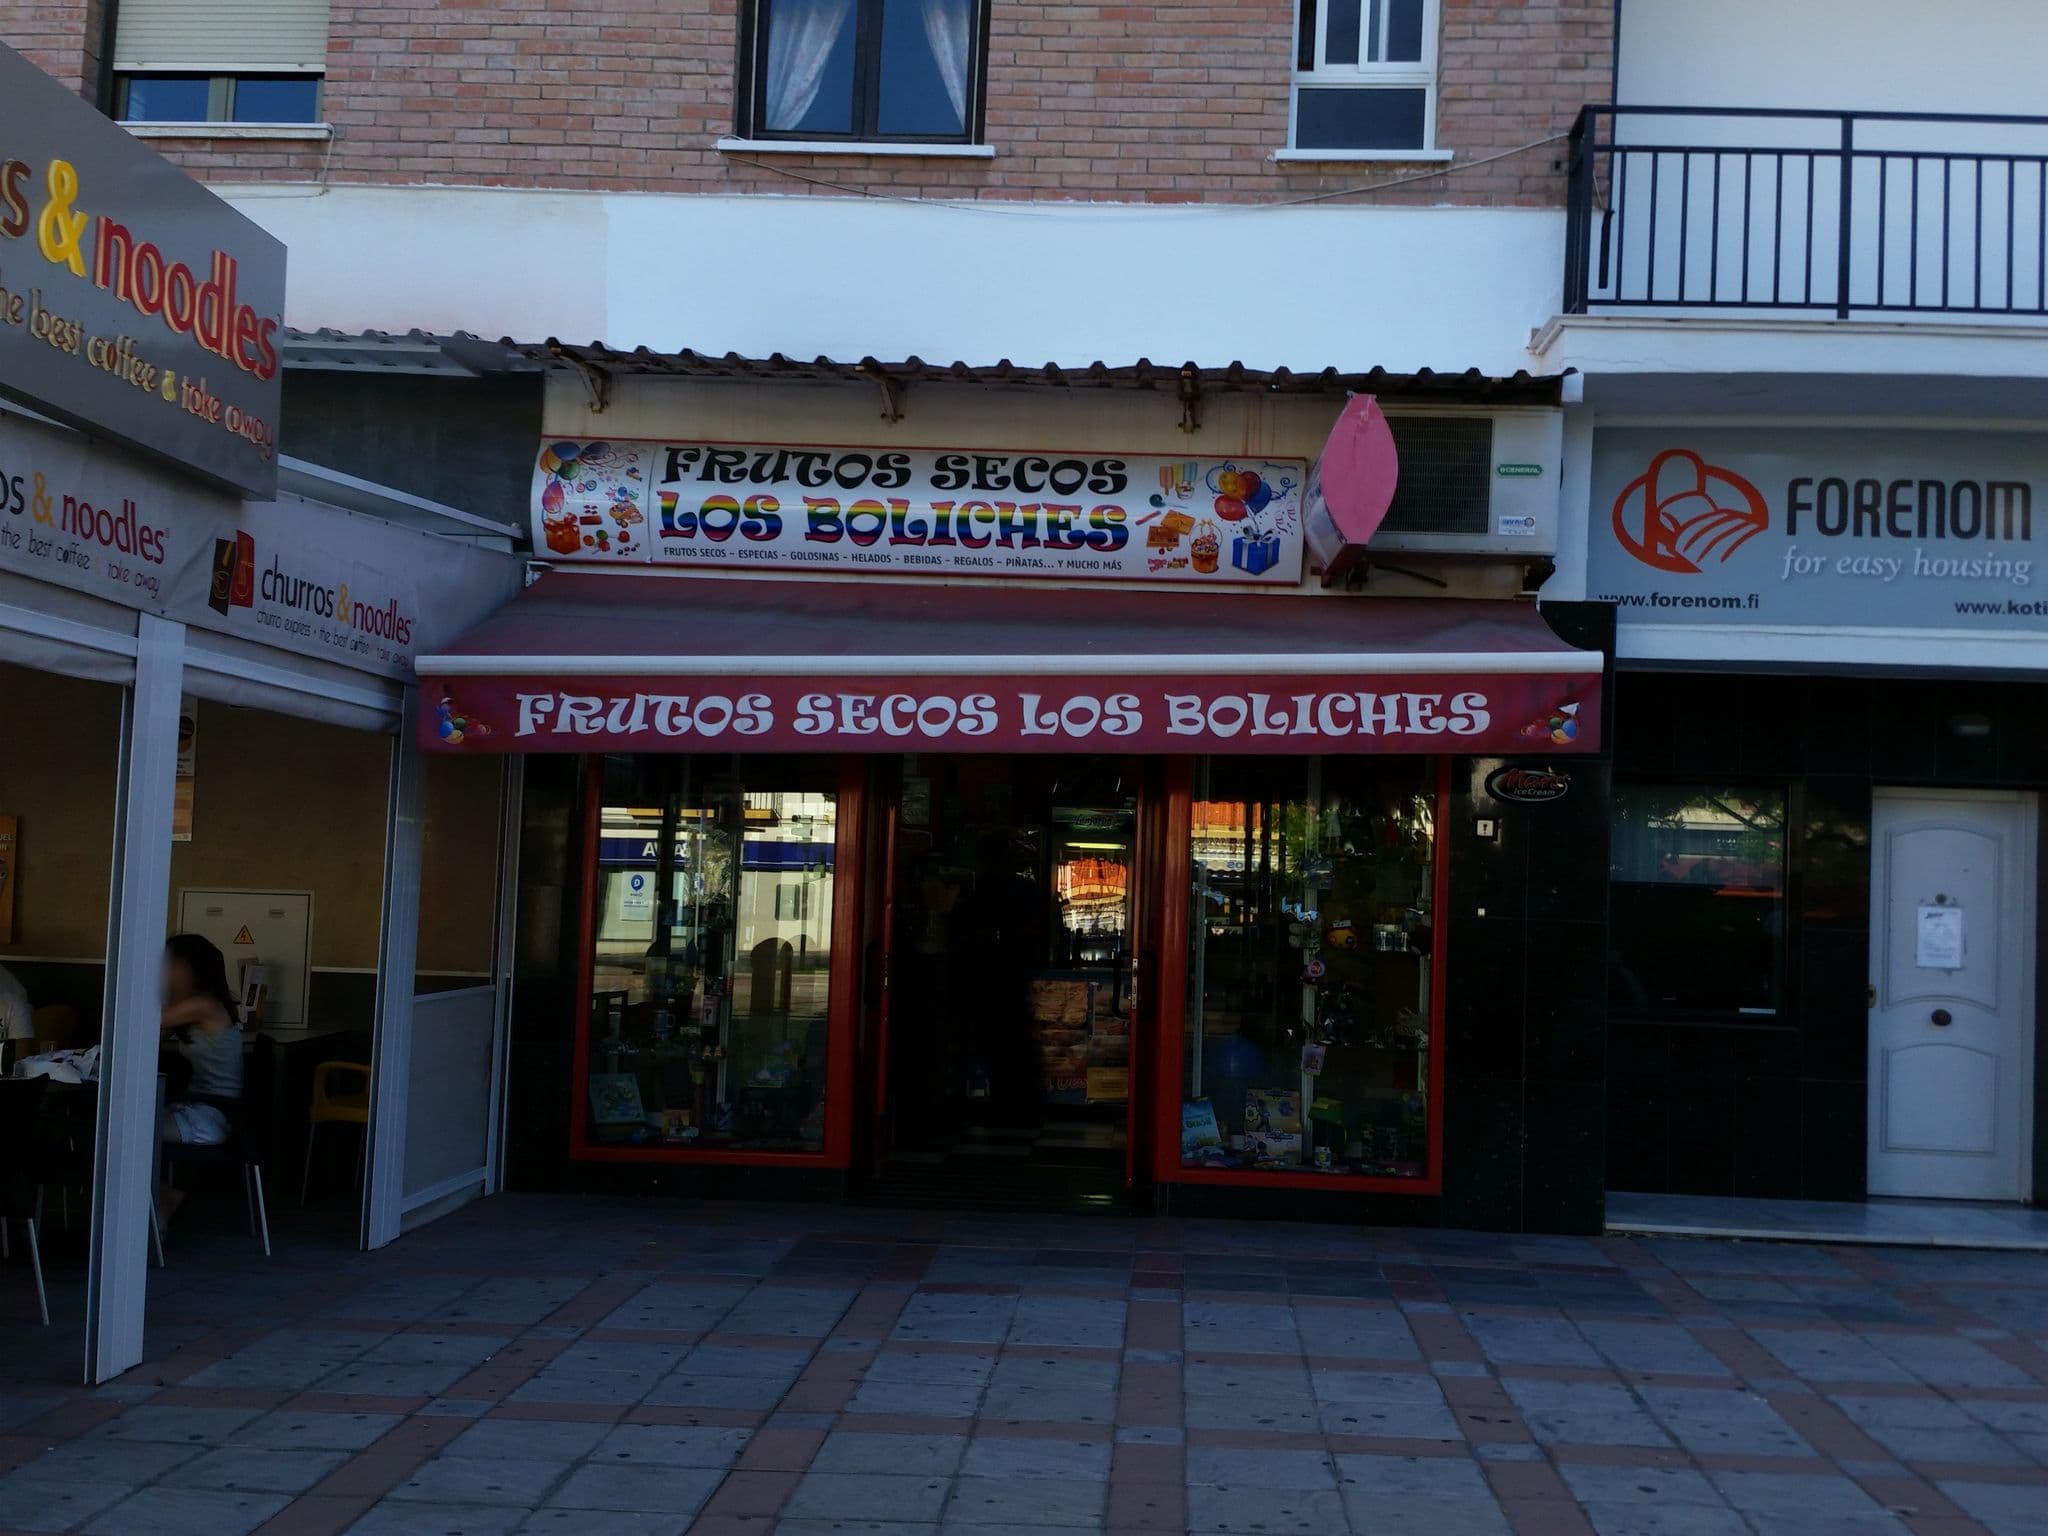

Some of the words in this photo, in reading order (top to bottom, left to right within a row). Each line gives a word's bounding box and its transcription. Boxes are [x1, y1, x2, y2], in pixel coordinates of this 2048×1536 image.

[37, 159, 88, 278] &
[93, 216, 278, 382] noodles
[29, 287, 85, 358] best
[87, 335, 158, 393] coffee
[181, 375, 222, 424] take
[225, 404, 273, 462] away
[661, 446, 911, 489] FRUTOS
[930, 455, 1128, 495] SECOS
[32, 471, 55, 528] &
[61, 494, 165, 565] noodles
[657, 491, 783, 541] LOS
[803, 495, 1129, 552] BOLICHES
[1786, 477, 2032, 541] FORENOM
[1, 520, 21, 550] the
[28, 528, 51, 558] best
[55, 542, 90, 571] coffee
[107, 559, 130, 583] take
[135, 572, 161, 600] away
[663, 547, 697, 558] FRUTOS
[700, 548, 726, 559] SECOS
[738, 549, 778, 560] ESPECIAS
[790, 551, 839, 562] GOLOSINAS
[851, 552, 891, 564] HELADOS
[904, 555, 942, 565] BEBIDAS
[954, 556, 994, 567] REGALOS
[1058, 559, 1064, 569] Y
[1067, 560, 1099, 570] MUCHO
[1103, 557, 1122, 571] MÁS
[1781, 544, 1826, 581] for
[1836, 553, 1901, 583] easy
[1913, 547, 2031, 585] housing
[262, 553, 334, 618] churros
[337, 583, 350, 624] &
[353, 598, 413, 645] noodles
[514, 691, 774, 737] FRUTOS
[793, 692, 999, 737] SECOS
[1019, 692, 1144, 737] LOS
[1163, 691, 1491, 738] BOLICHES
